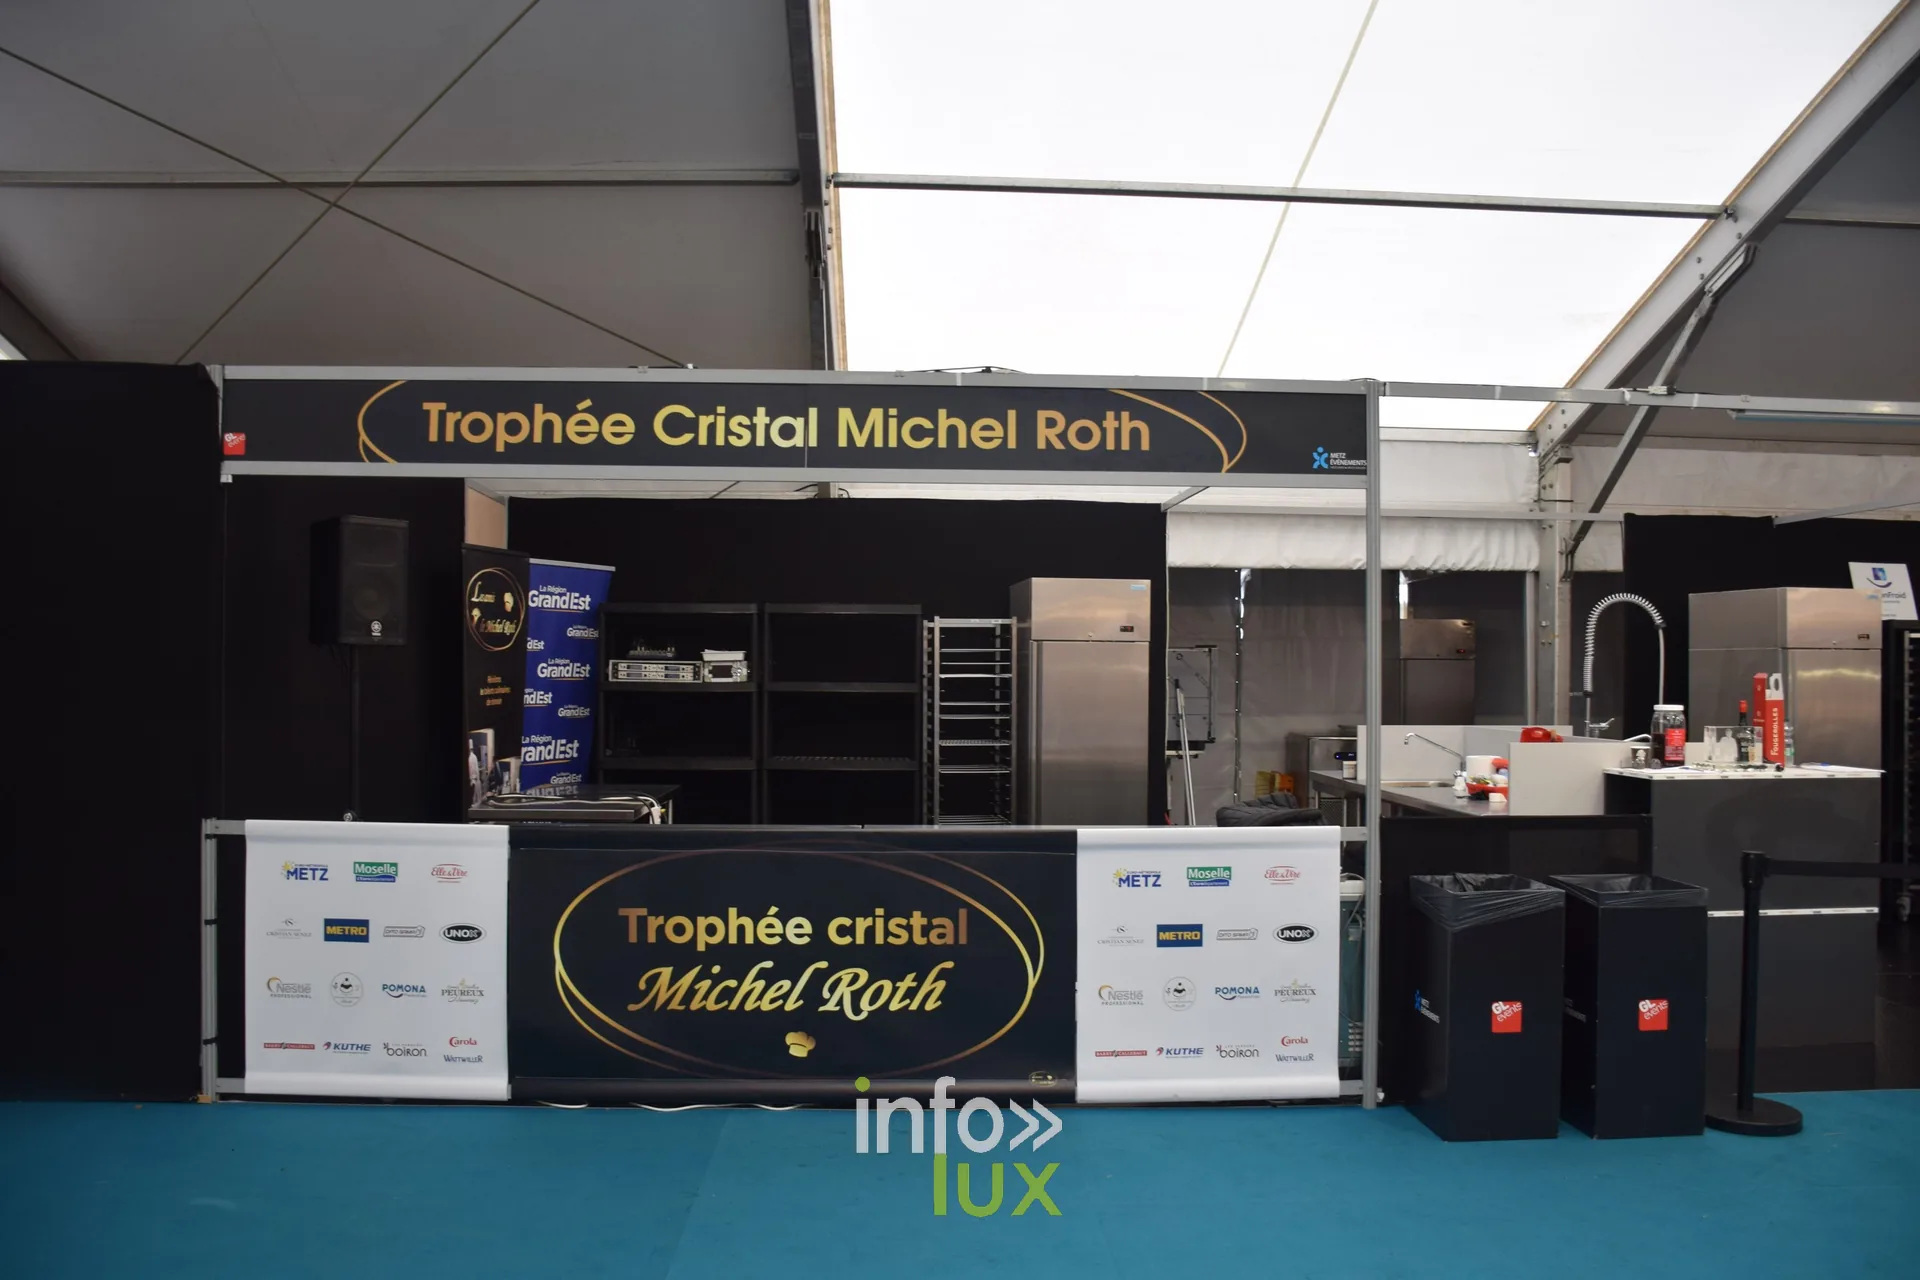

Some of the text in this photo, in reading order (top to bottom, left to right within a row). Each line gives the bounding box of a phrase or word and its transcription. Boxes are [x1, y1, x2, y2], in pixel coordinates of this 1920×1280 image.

[422, 398, 1151, 452] Trophée Cristal Michel Roth
[547, 585, 567, 594] Région
[521, 735, 553, 745] La Région
[286, 867, 329, 881] METZ
[354, 863, 397, 875] Moselle
[1188, 867, 1231, 879] Moselle
[1118, 874, 1162, 888] METZ
[326, 925, 367, 936] METRO
[444, 929, 479, 938] UNOX
[618, 905, 967, 951] Trophée cristal
[1278, 929, 1312, 938] UNOX
[1159, 931, 1201, 941] METRO
[382, 983, 427, 993] POMONA
[441, 989, 485, 997] PEUREUX
[626, 960, 955, 1021] Michel Roth
[1214, 986, 1260, 995] POMONA
[1274, 988, 1316, 997] PEUREUX
[1491, 1001, 1510, 1015] GL
[1496, 1002, 1522, 1022] events
[1638, 999, 1656, 1013] GL
[1643, 1000, 1669, 1020] events
[333, 1043, 371, 1051] KUTHE
[449, 1036, 478, 1048] Carola
[1281, 1035, 1309, 1047] Carola
[1165, 1047, 1204, 1056] KUTHE
